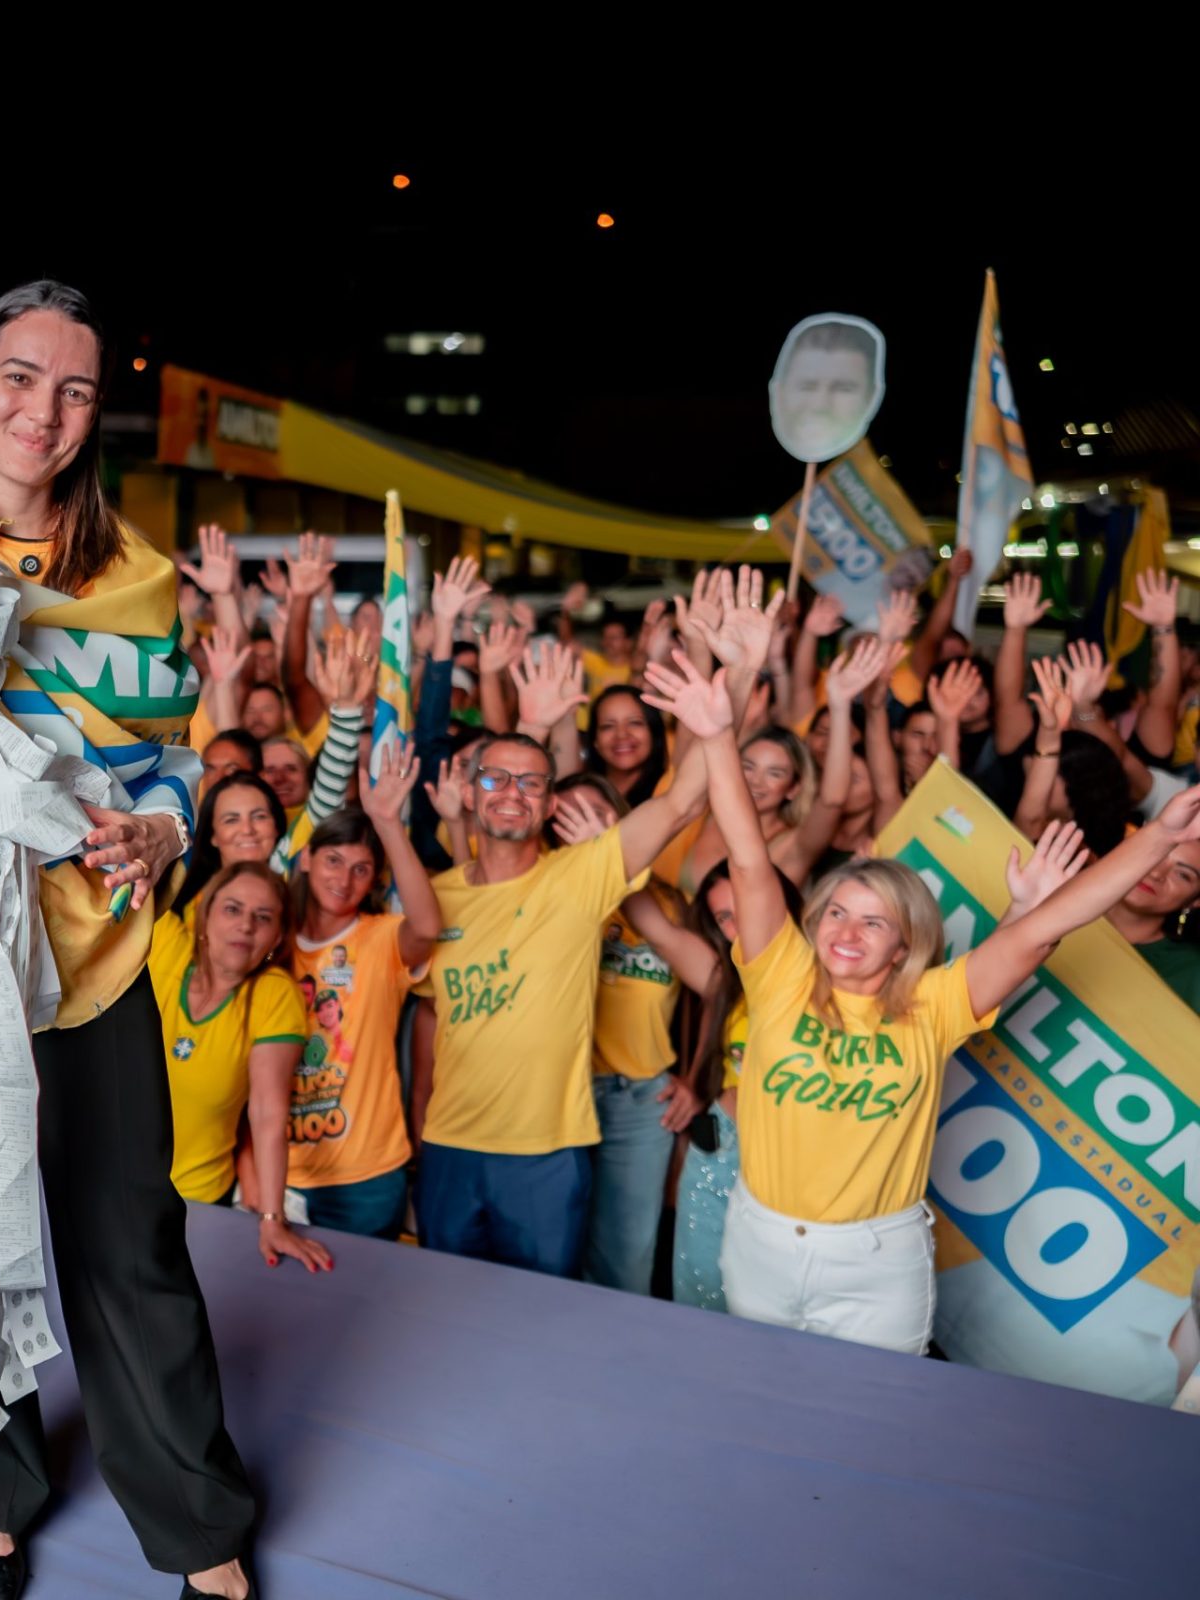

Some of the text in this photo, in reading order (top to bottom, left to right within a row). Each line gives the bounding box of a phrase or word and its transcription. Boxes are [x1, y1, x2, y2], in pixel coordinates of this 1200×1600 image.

[790, 1012, 904, 1069] BORA
[762, 1052, 923, 1122] GOIÁS!
[1053, 1119, 1185, 1242] ESTADUAL
